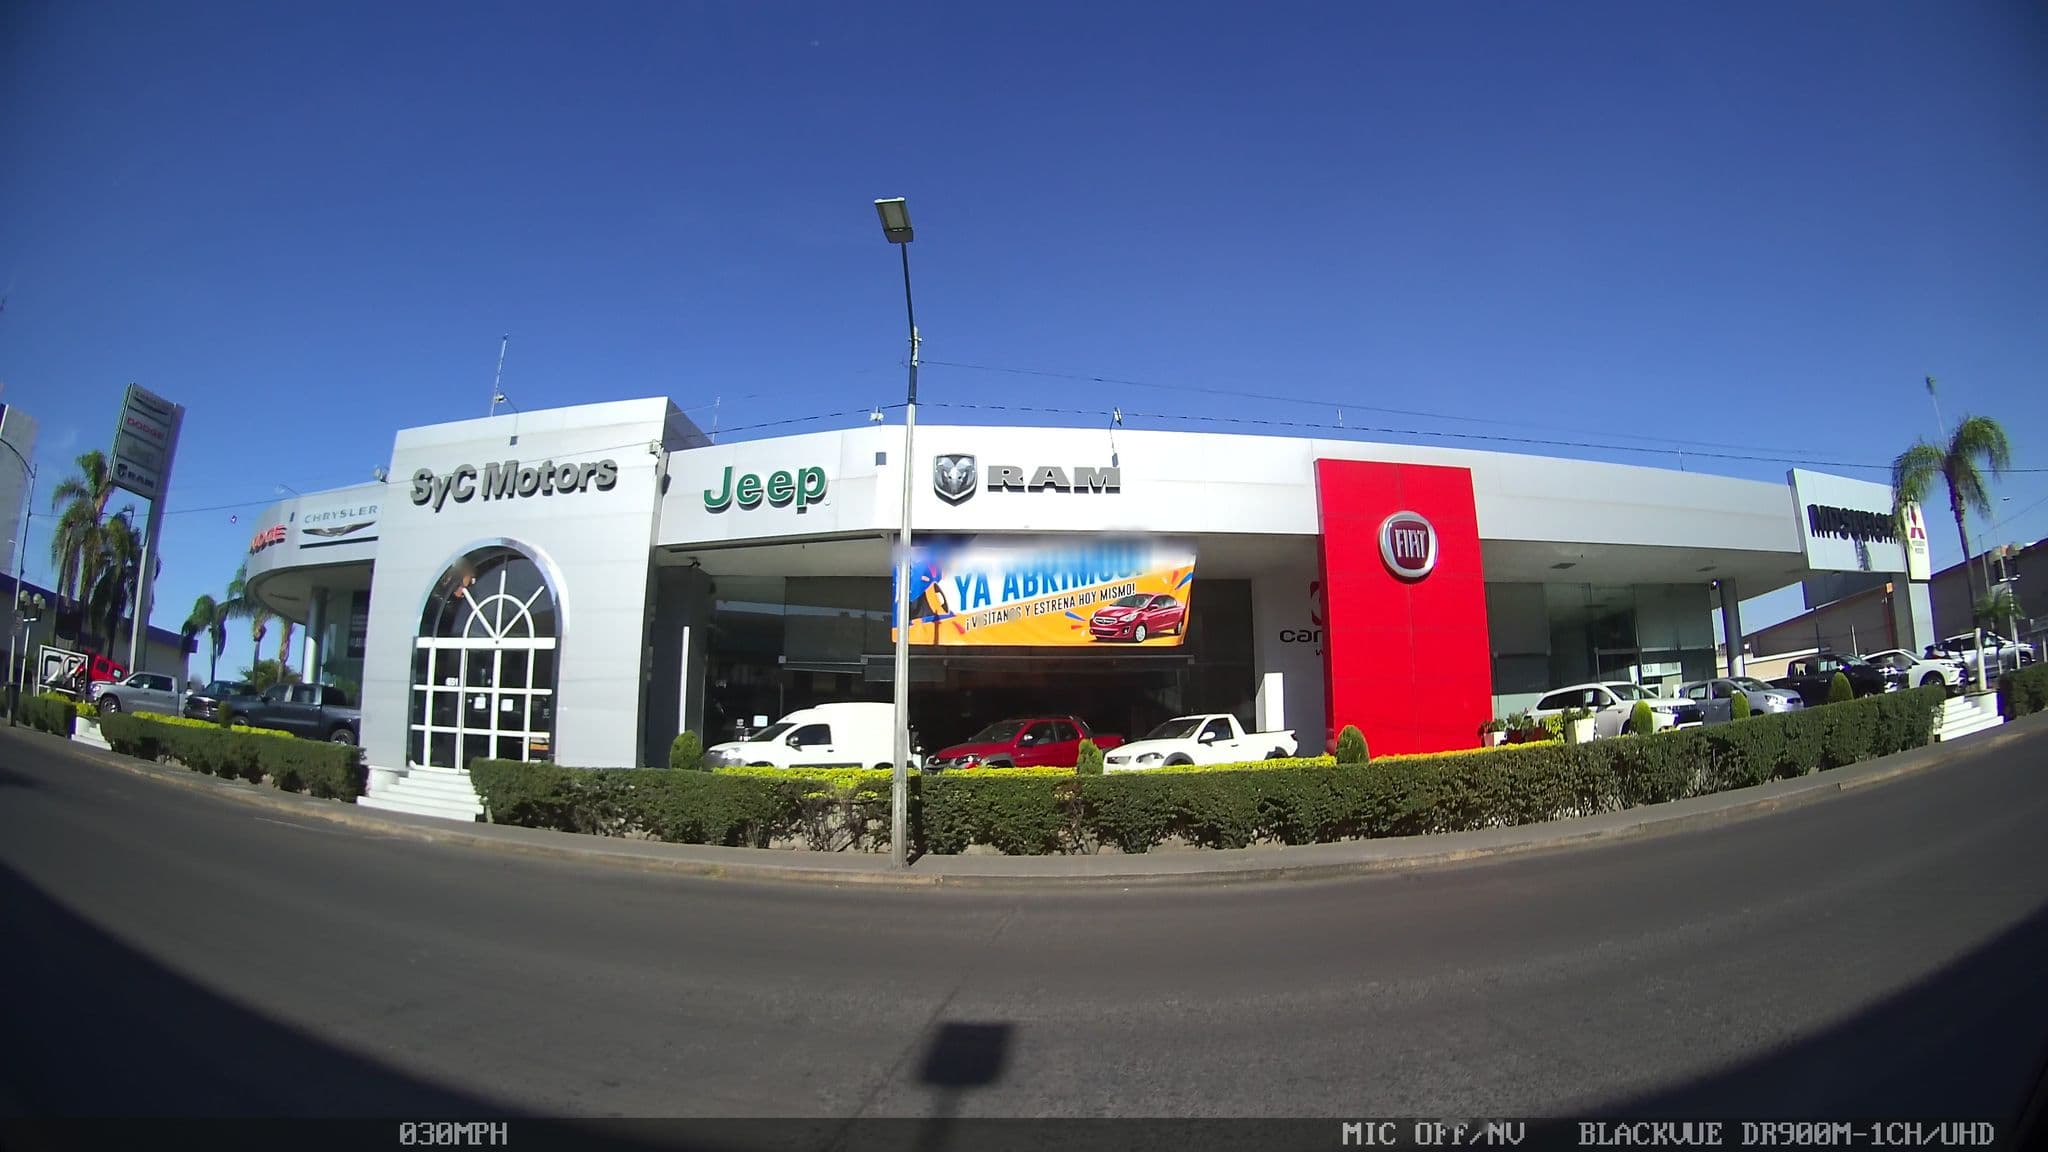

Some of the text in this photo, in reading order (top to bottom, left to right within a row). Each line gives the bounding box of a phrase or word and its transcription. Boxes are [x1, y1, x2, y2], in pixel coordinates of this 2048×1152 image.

[411, 459, 618, 512] SyC Motors
[703, 466, 826, 511] Jeep
[987, 465, 1122, 493] RAM
[304, 505, 378, 524] CHRYSLER
[1395, 529, 1426, 558] FIAT
[955, 572, 991, 611] YA
[966, 583, 1136, 631] ¡VSÍTANS Y ESTRENA HOY MISMO!
